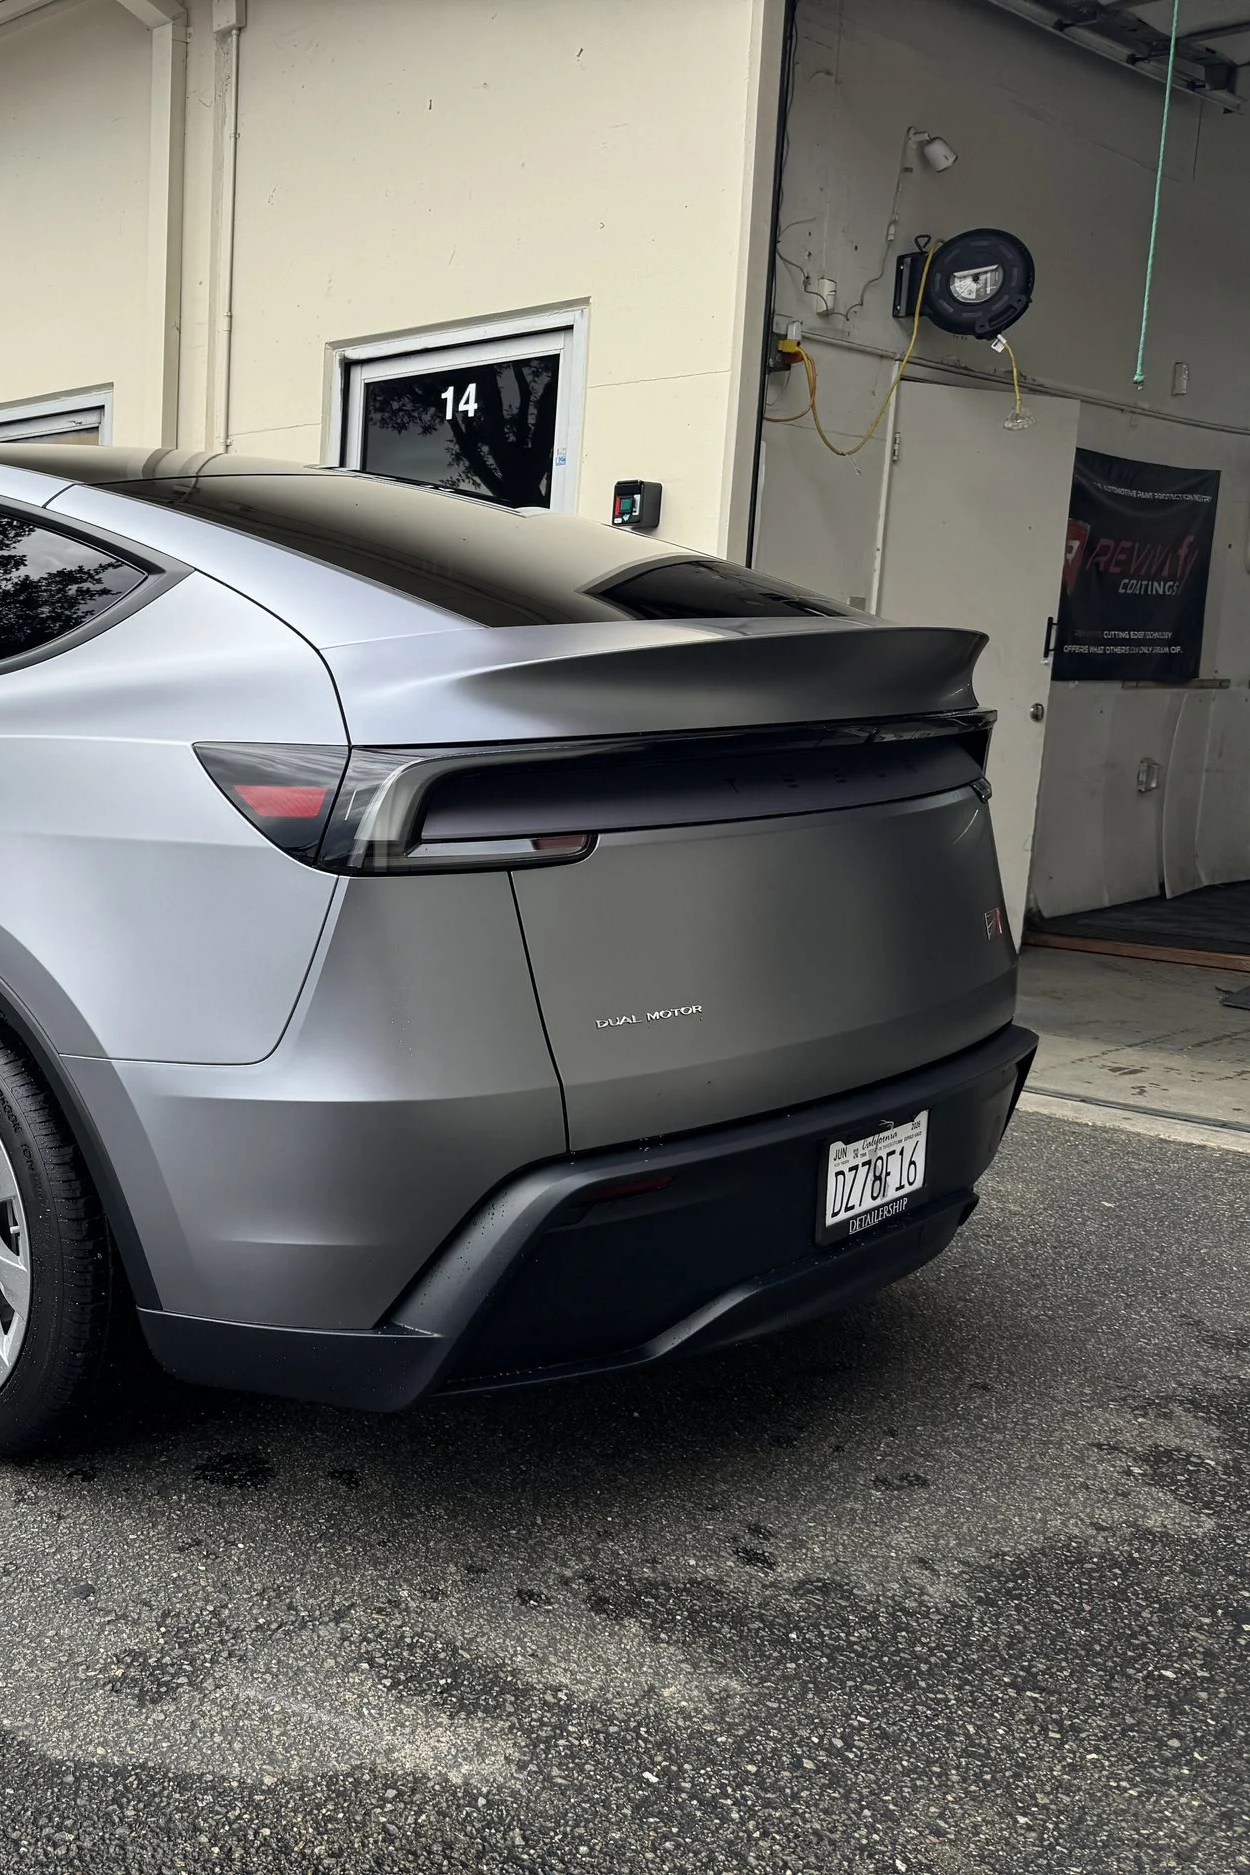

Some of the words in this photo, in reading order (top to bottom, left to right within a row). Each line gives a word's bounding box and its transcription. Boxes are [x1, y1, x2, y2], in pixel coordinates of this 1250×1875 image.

[441, 383, 478, 420] 14
[1118, 579, 1180, 596] COATINGS
[1103, 630, 1129, 639] CUTTING
[1063, 645, 1088, 653] OFFERS
[1105, 646, 1130, 654] OTHERS
[1170, 646, 1183, 654] OF.
[596, 1014, 642, 1029] DUAL
[646, 1004, 702, 1021] MOTOR
[833, 1147, 848, 1162] JUN
[862, 1132, 898, 1152] California
[831, 1140, 919, 1218] DZ78F16
[849, 1197, 908, 1233] DETAILERSHIP
